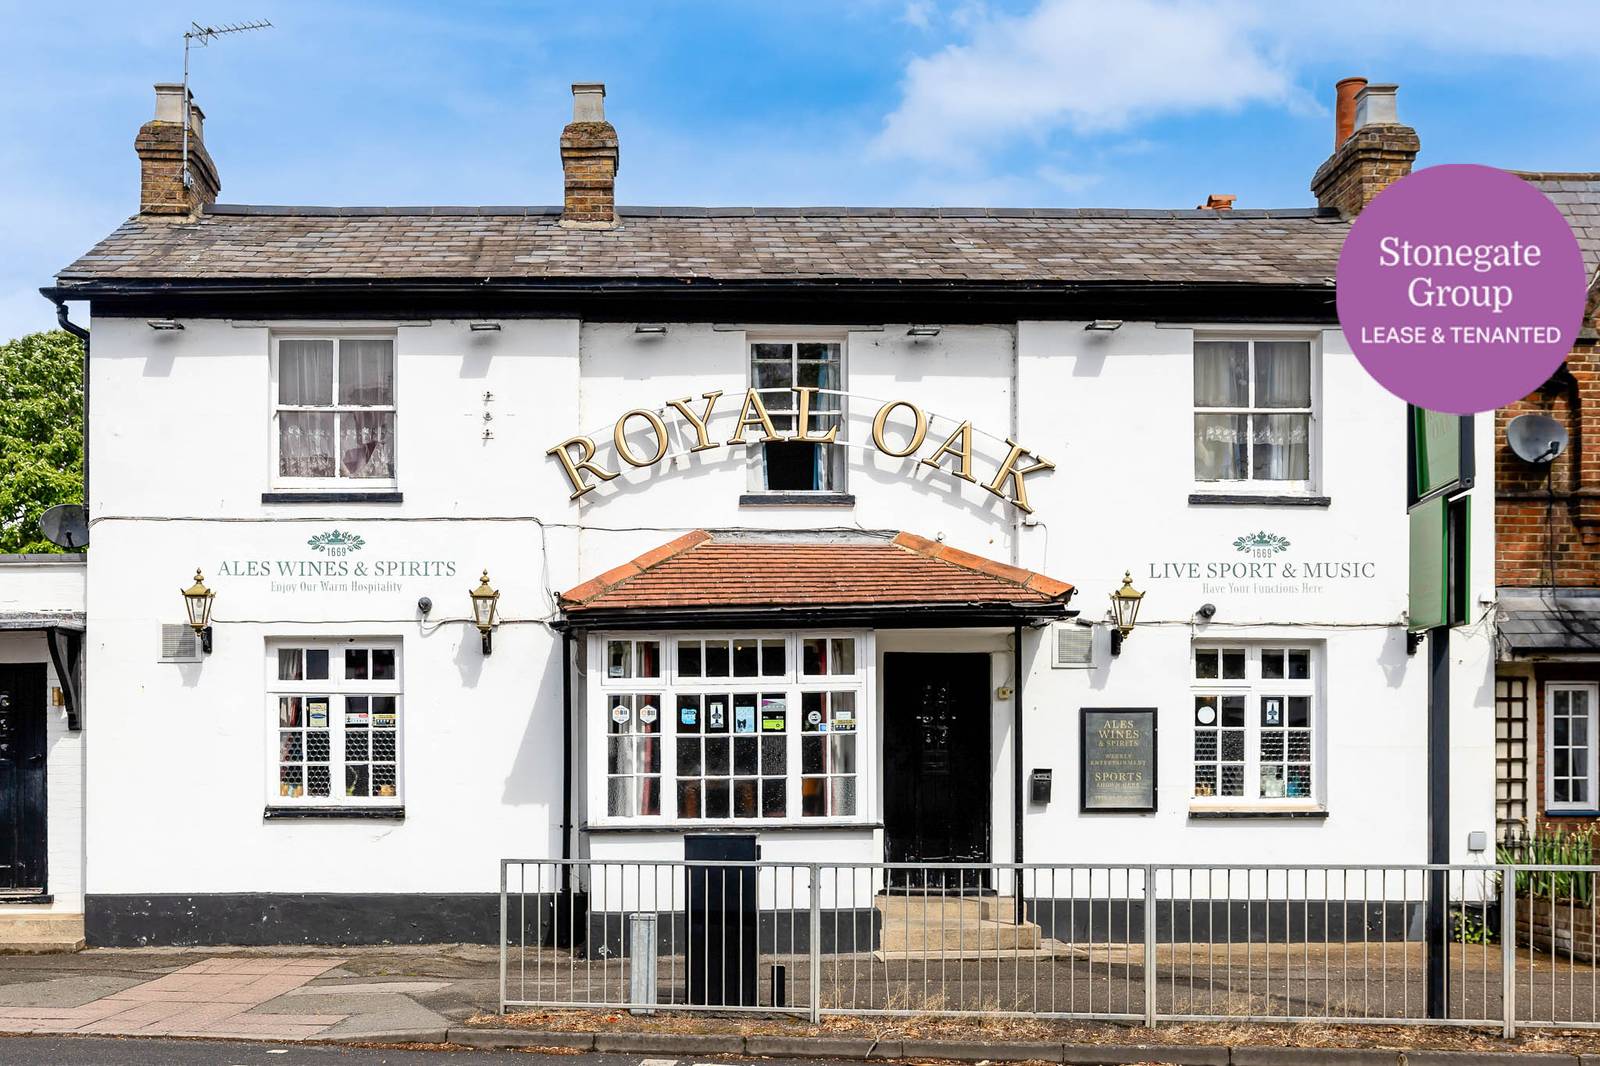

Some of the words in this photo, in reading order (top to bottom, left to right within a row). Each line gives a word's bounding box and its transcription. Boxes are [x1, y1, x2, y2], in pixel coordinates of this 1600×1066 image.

[546, 386, 839, 501] ROYAL
[871, 399, 1057, 514] OAK
[326, 547, 347, 557] 1669
[1252, 548, 1272, 559] 1669
[217, 560, 271, 577] ALES
[276, 560, 349, 577] WINES
[354, 560, 368, 577] &
[374, 560, 457, 577] SPIRITS
[1149, 562, 1201, 579] LIVE
[1206, 562, 1277, 579] SPORT
[1281, 562, 1297, 579] &
[1303, 562, 1376, 579] MUSIC
[271, 580, 298, 595] Enjoy
[299, 580, 317, 593] Our
[320, 580, 348, 593] Warm
[351, 580, 403, 594] Hospitality
[1202, 582, 1226, 594] Have
[1228, 582, 1250, 594] Your
[1253, 582, 1300, 594] Functions
[1302, 582, 1323, 594] Here
[1103, 719, 1134, 729] ALES
[1098, 729, 1140, 739] WINES
[1095, 772, 1142, 781] SPORTS
